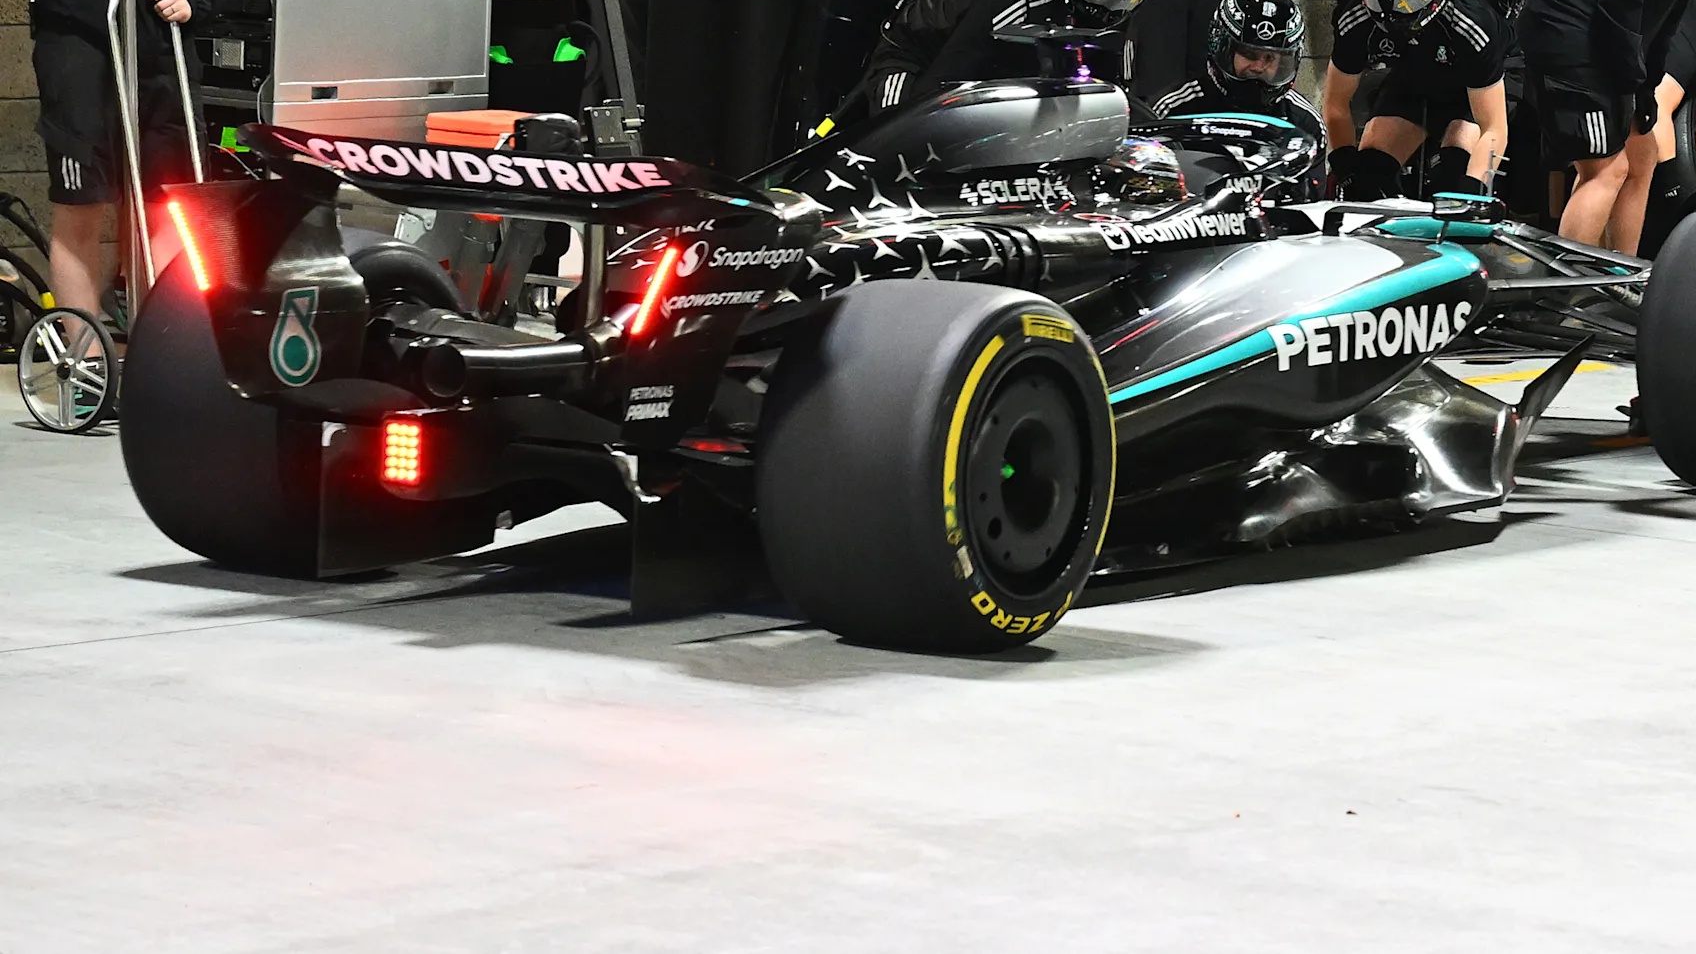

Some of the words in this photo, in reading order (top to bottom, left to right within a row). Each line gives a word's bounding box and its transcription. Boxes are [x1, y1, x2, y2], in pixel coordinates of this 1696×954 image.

[306, 136, 672, 195] CROWDSTRIKE
[977, 177, 1059, 207] SOLERA
[1128, 207, 1247, 243] TeamViewer
[708, 245, 804, 271] Snapdragon
[667, 289, 765, 311] CROWDSTRIKE
[1267, 300, 1471, 372] PETRONAS
[629, 384, 674, 401] PETRONAS
[970, 590, 1050, 635] ZERO
